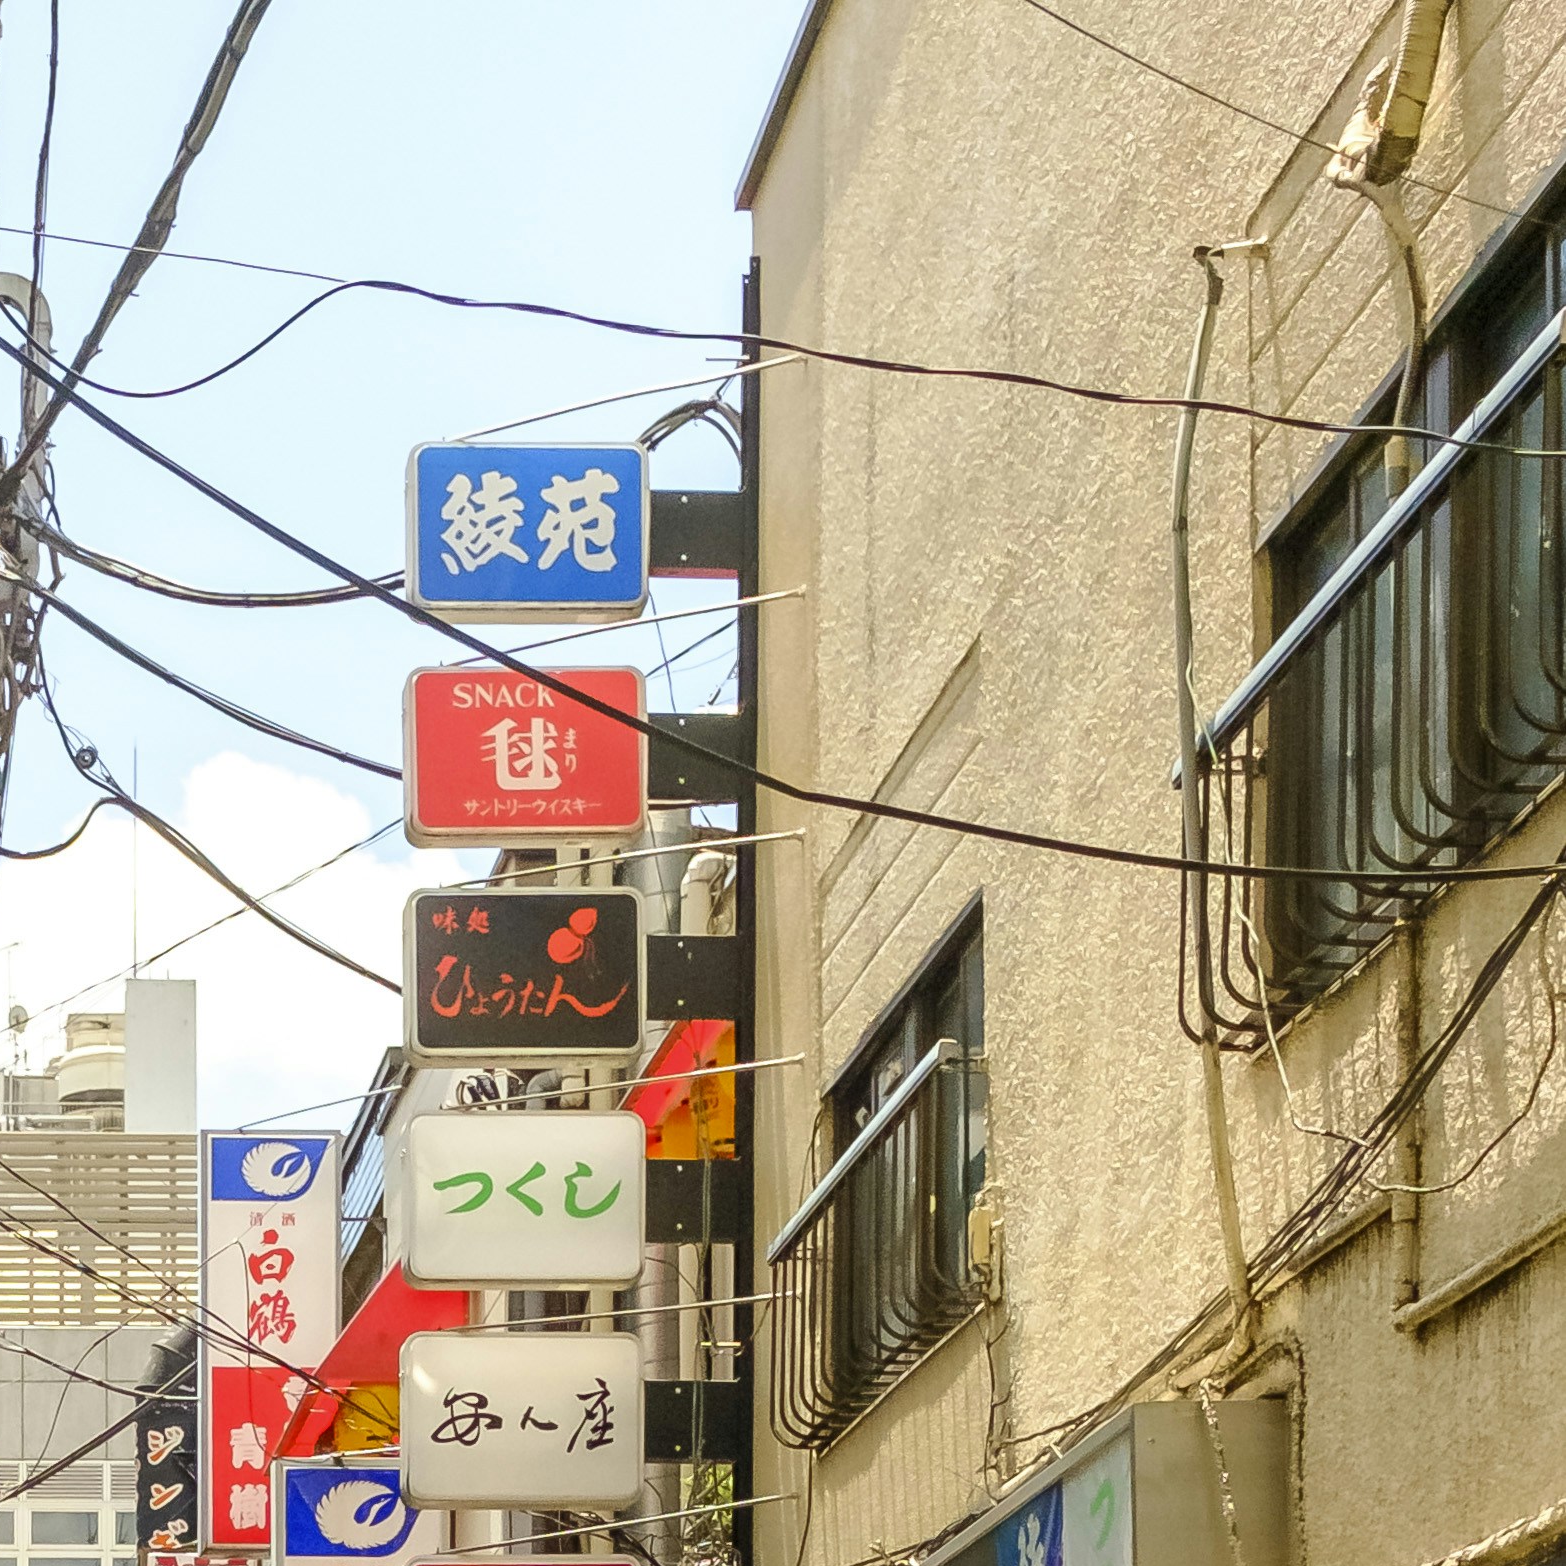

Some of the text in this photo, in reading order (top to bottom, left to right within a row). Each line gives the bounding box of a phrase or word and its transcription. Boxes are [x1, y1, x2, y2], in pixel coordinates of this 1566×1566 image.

[452, 683, 556, 709] SNACK
[480, 717, 578, 791] 毬 まり
[463, 799, 603, 818] サントリーウイスキー
[432, 906, 491, 935] 味処
[430, 954, 630, 1018] ひょうたん
[433, 1161, 622, 1219] つくし
[249, 1212, 297, 1227] 清酒
[248, 1229, 297, 1346] 白鶴
[229, 1422, 268, 1531] 青樹
